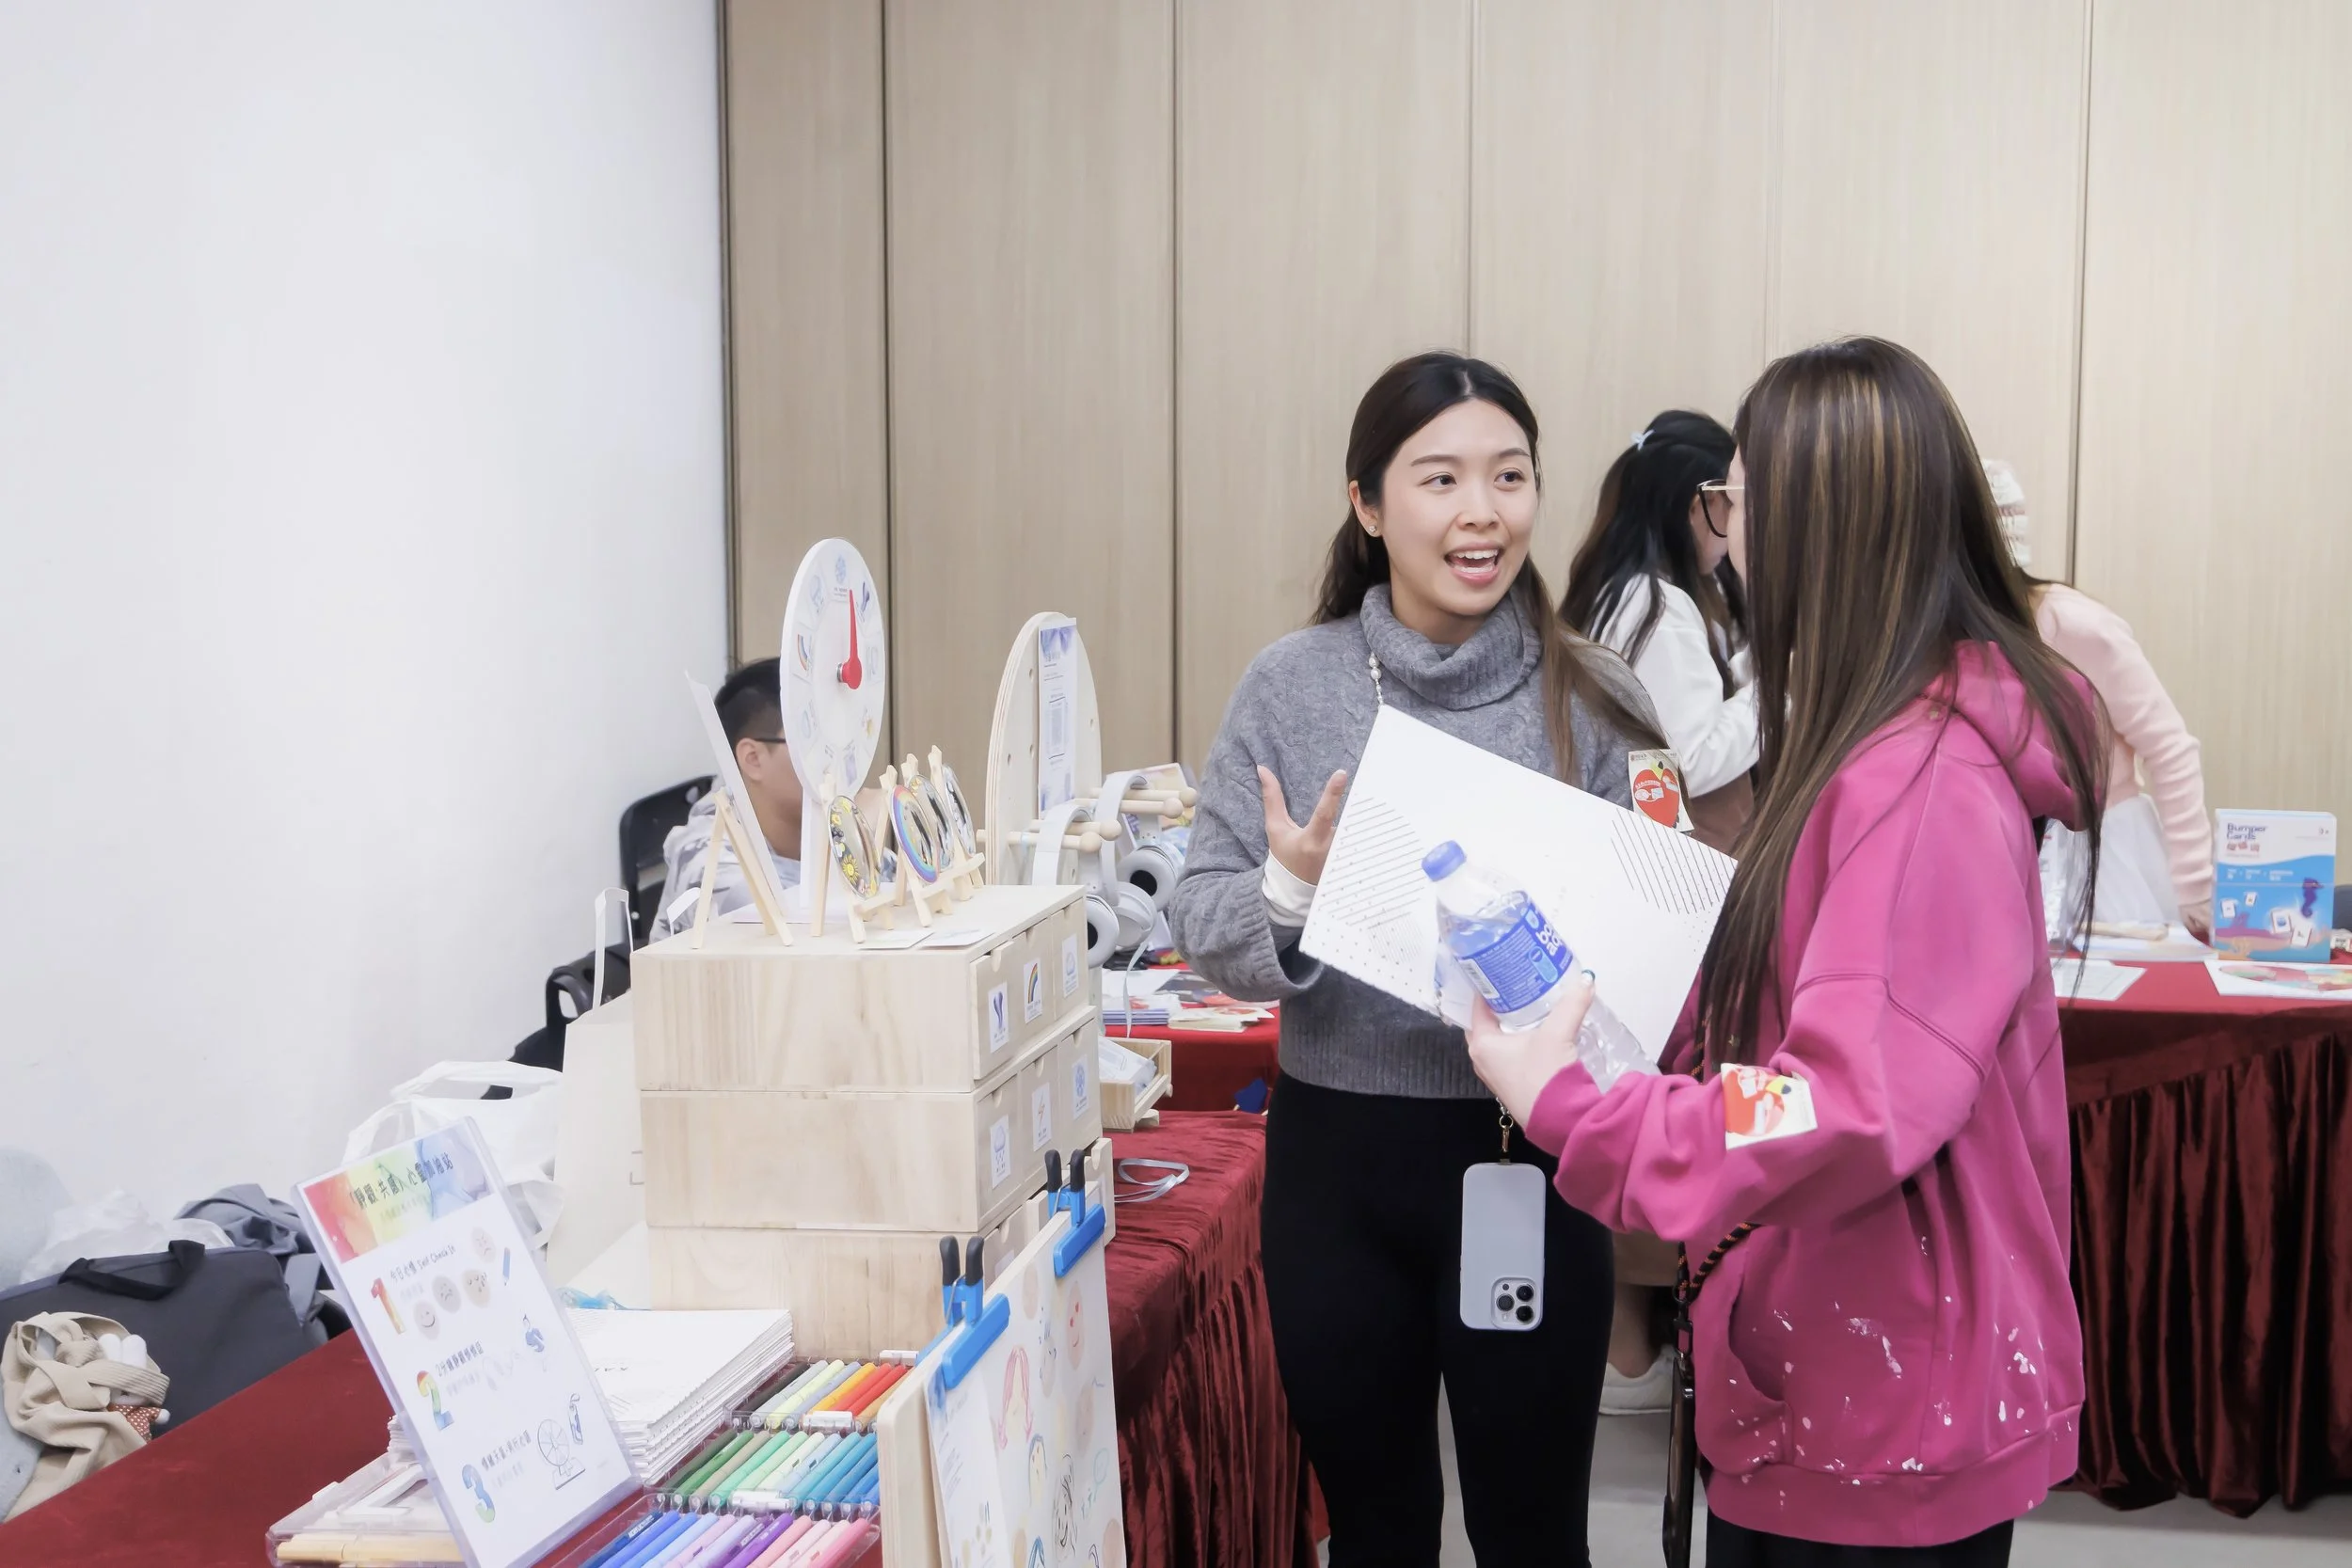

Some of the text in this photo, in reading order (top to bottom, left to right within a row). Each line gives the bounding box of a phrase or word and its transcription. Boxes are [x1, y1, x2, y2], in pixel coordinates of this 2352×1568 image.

[2226, 832, 2257, 840] Cards
[2227, 823, 2267, 833] Bumper
[1535, 923, 1553, 944] bo
[371, 1277, 405, 1335] 1
[417, 1370, 454, 1431] 2
[461, 1464, 496, 1523] 3
